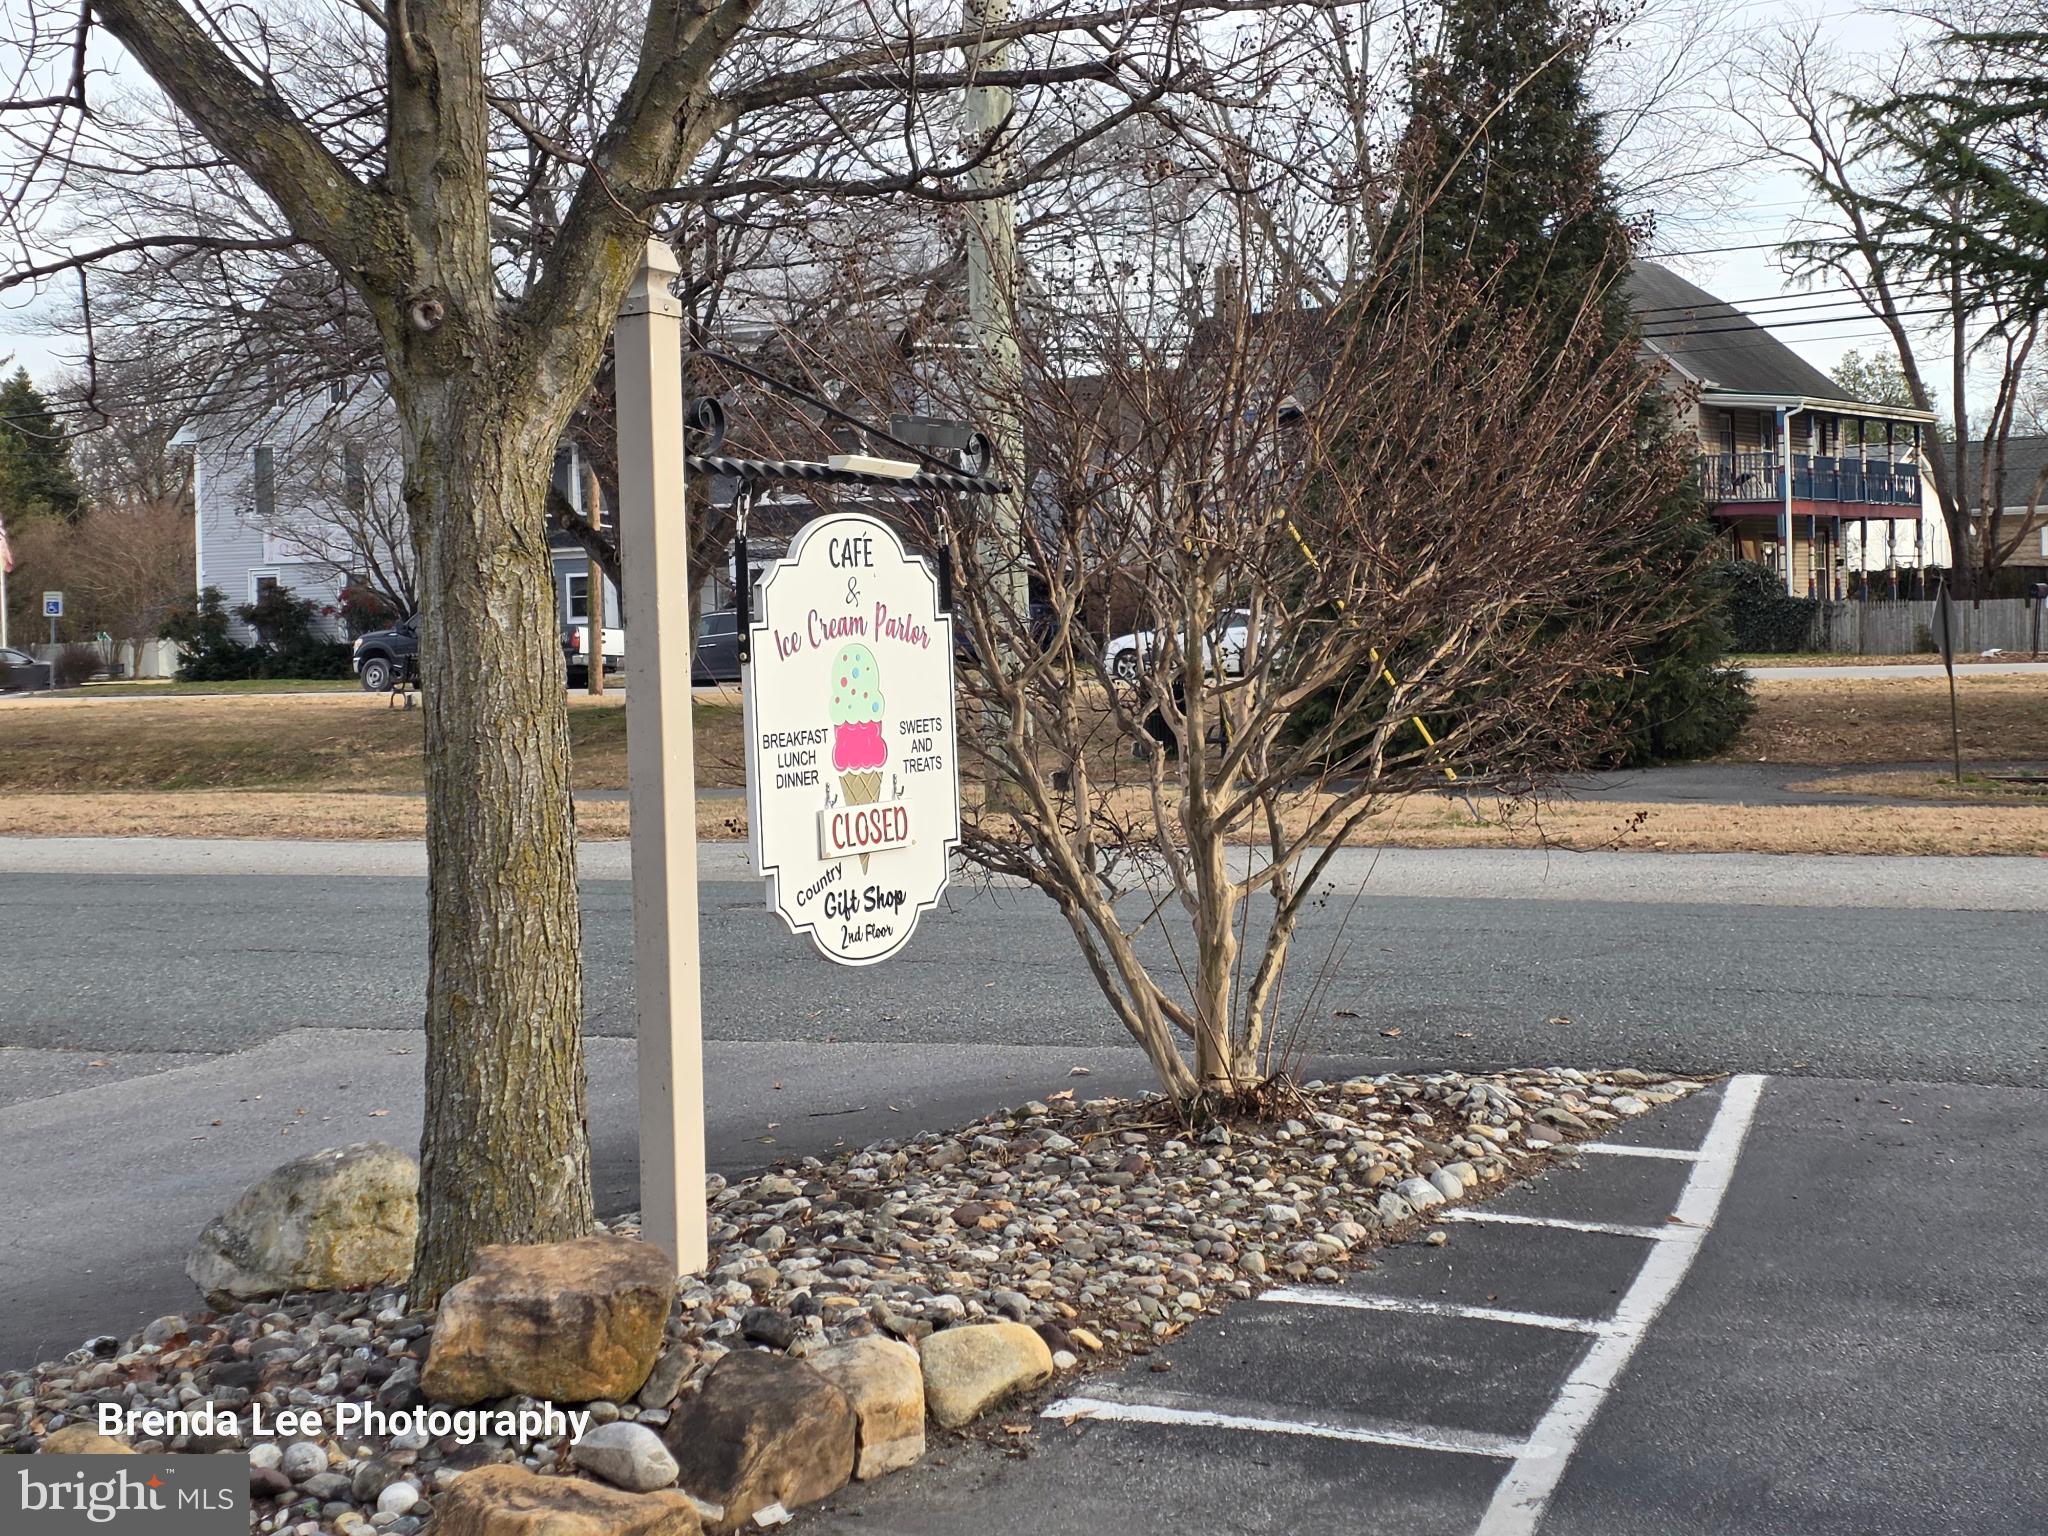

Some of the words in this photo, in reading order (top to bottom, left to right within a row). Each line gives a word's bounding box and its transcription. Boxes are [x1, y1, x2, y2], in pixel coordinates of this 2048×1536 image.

[829, 531, 874, 568] CAFÉ
[845, 576, 861, 607] &
[774, 630, 801, 661] Ice
[807, 609, 868, 649] Cream
[875, 601, 931, 650] Parlor
[762, 729, 828, 749] BREAKFAST
[899, 717, 943, 735] SWEETS
[911, 738, 933, 753] AND
[777, 750, 816, 769] LUNCH
[903, 756, 942, 774] TREATS
[776, 770, 820, 789] DINNER
[832, 806, 908, 850] CLOSED
[796, 862, 843, 907] Country
[824, 890, 859, 921] Gift
[863, 886, 906, 916] Shop
[841, 924, 864, 950] 2nd
[865, 924, 894, 943] Floor
